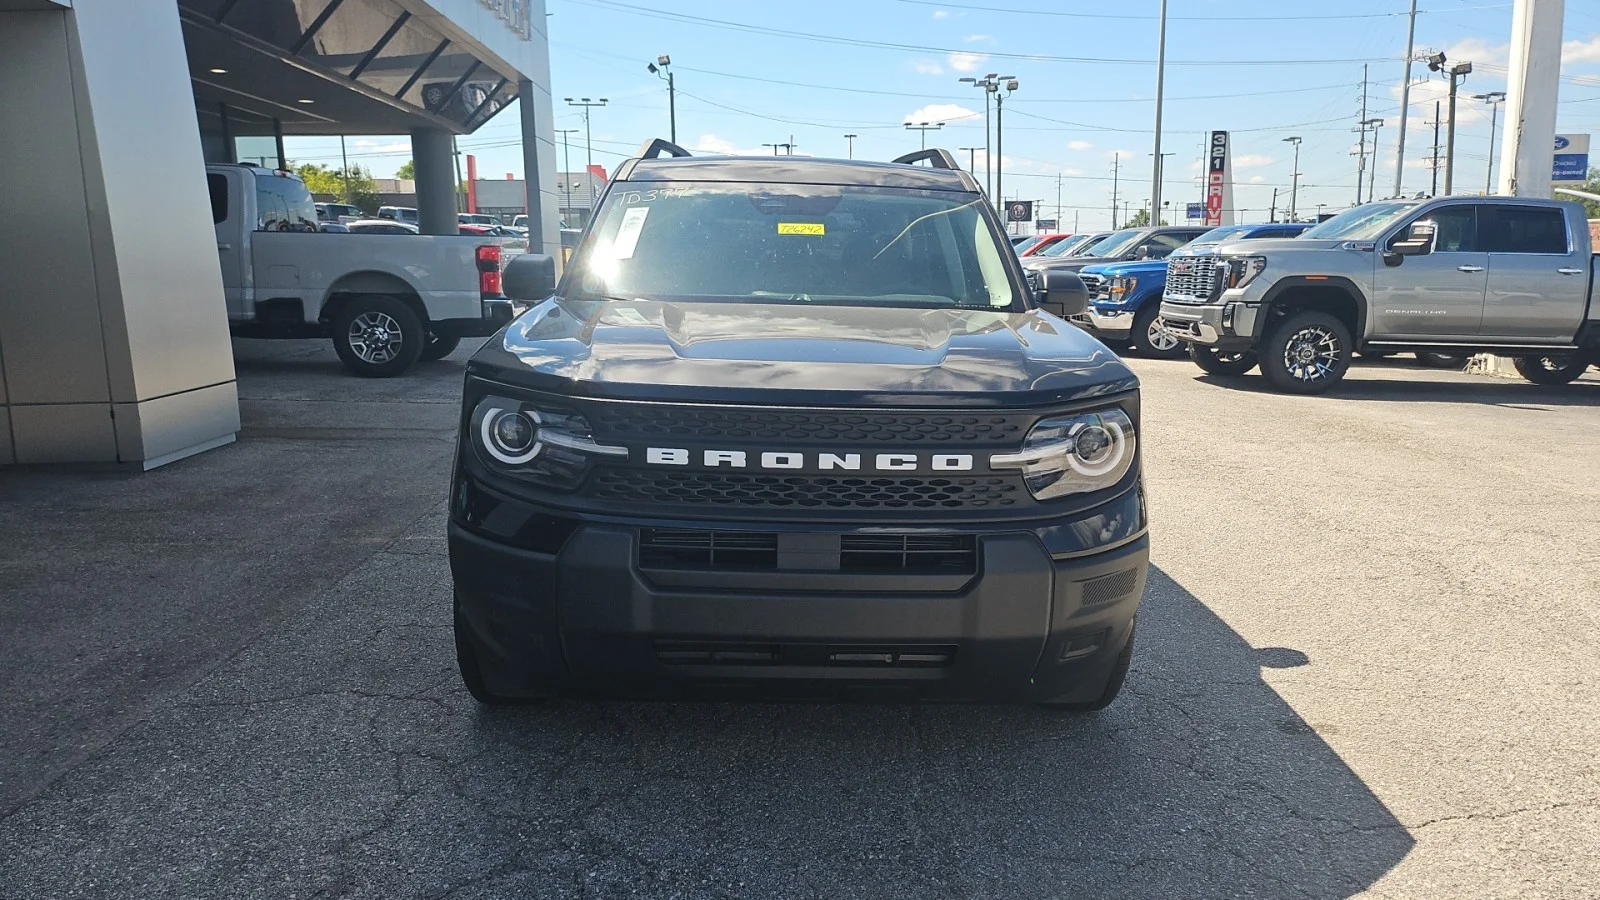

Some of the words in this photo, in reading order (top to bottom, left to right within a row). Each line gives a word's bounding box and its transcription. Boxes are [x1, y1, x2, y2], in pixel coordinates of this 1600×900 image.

[1212, 134, 1225, 169] 321
[1208, 174, 1223, 226] DRIVE
[780, 224, 823, 234] T26242
[646, 447, 973, 470] BRONCO
